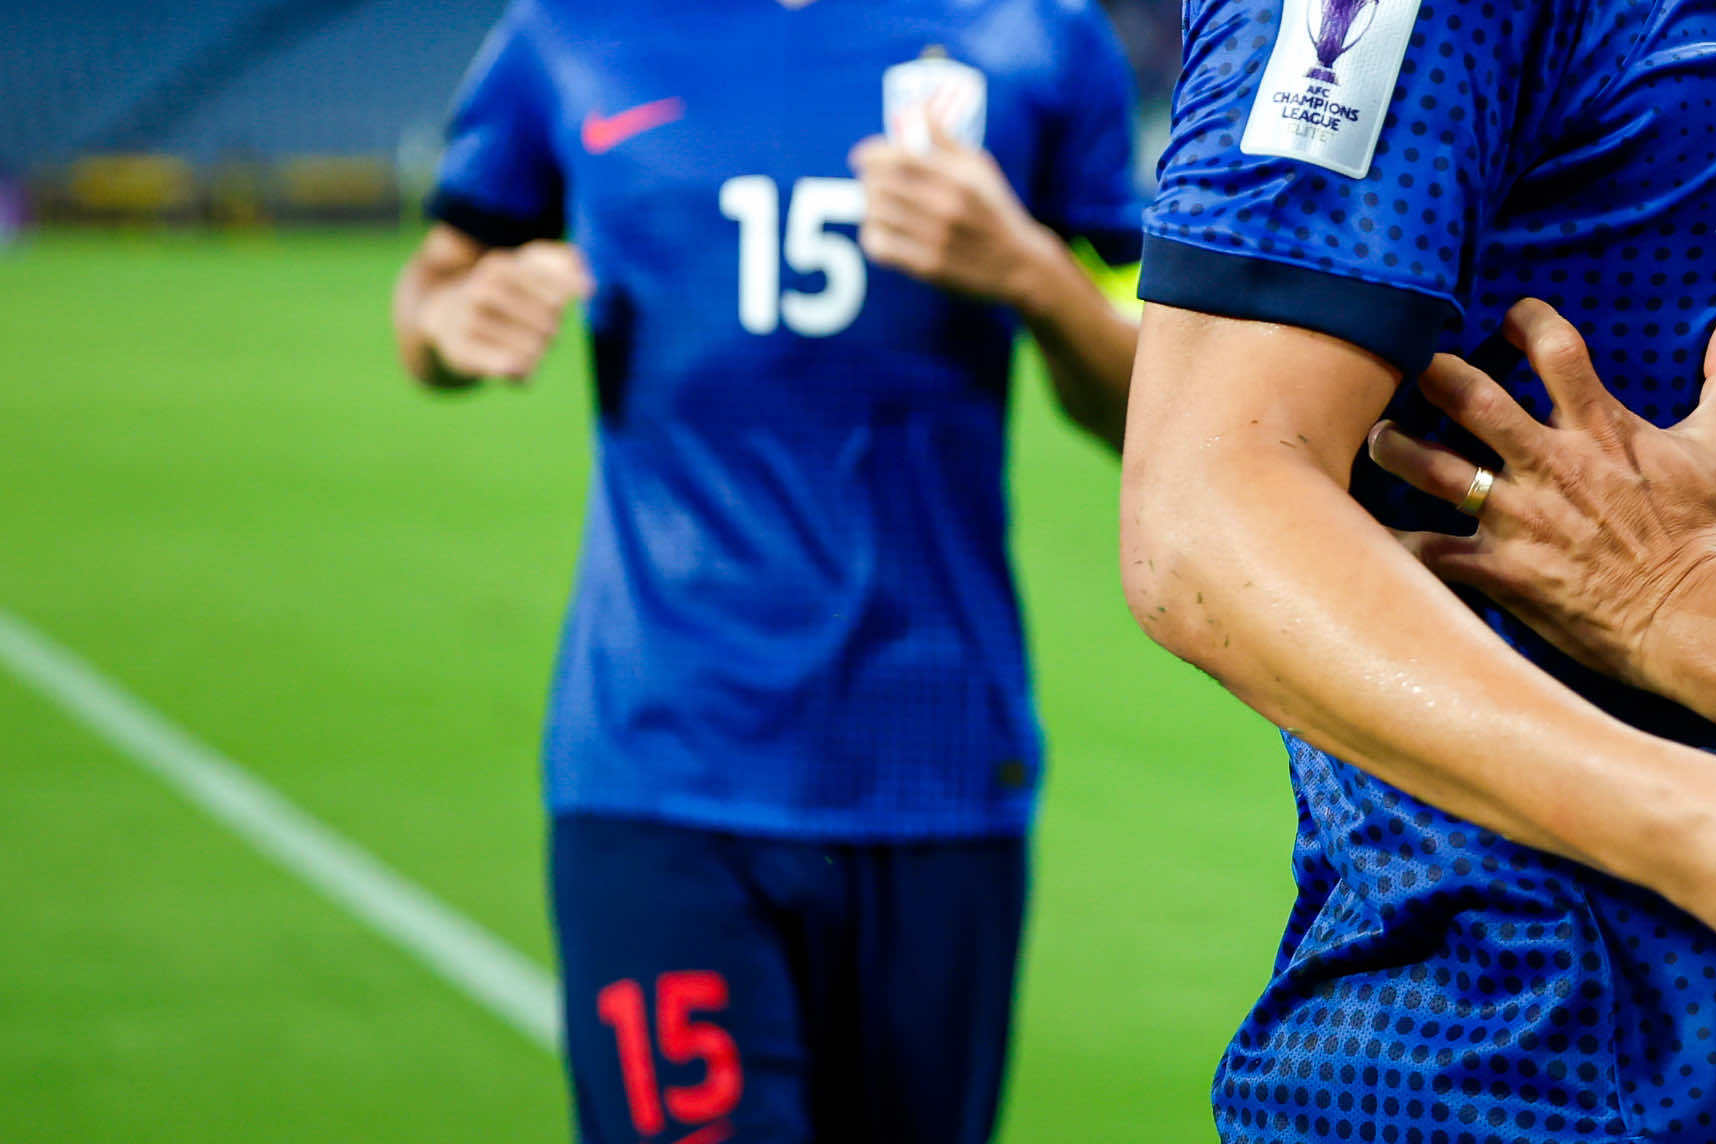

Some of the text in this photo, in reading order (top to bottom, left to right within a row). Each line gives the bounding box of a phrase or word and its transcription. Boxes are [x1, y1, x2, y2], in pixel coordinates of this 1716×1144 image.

[1307, 86, 1331, 97] AFC
[1273, 92, 1360, 121] CHAMPIONS
[1282, 106, 1341, 131] LEAGUE
[719, 174, 867, 337] 15
[597, 969, 744, 1136] 15
